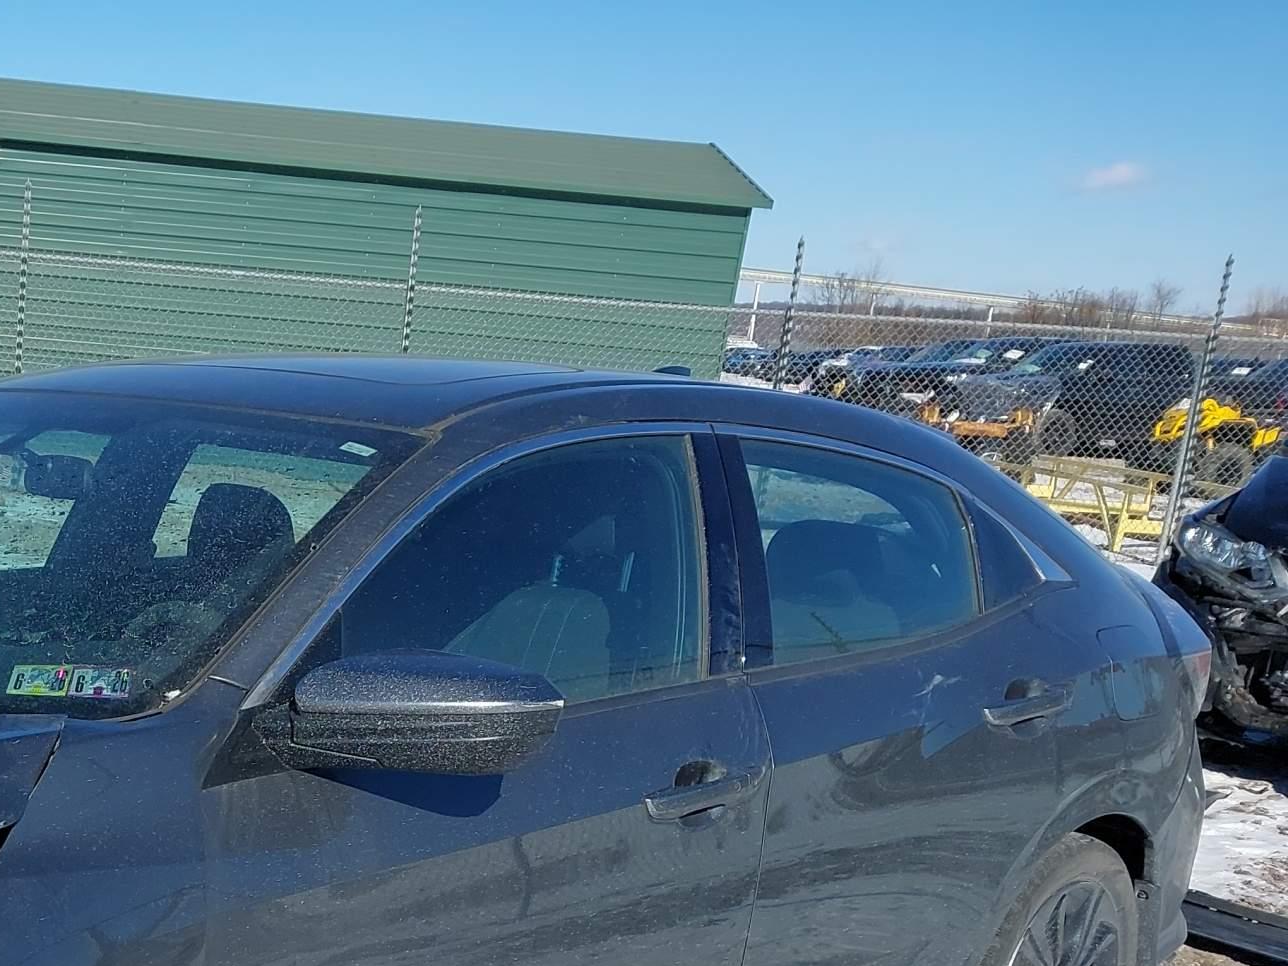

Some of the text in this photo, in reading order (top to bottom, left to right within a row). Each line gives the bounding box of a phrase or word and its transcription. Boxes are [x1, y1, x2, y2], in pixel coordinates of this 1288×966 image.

[13, 673, 25, 690] 6
[75, 670, 130, 693] 6 26
